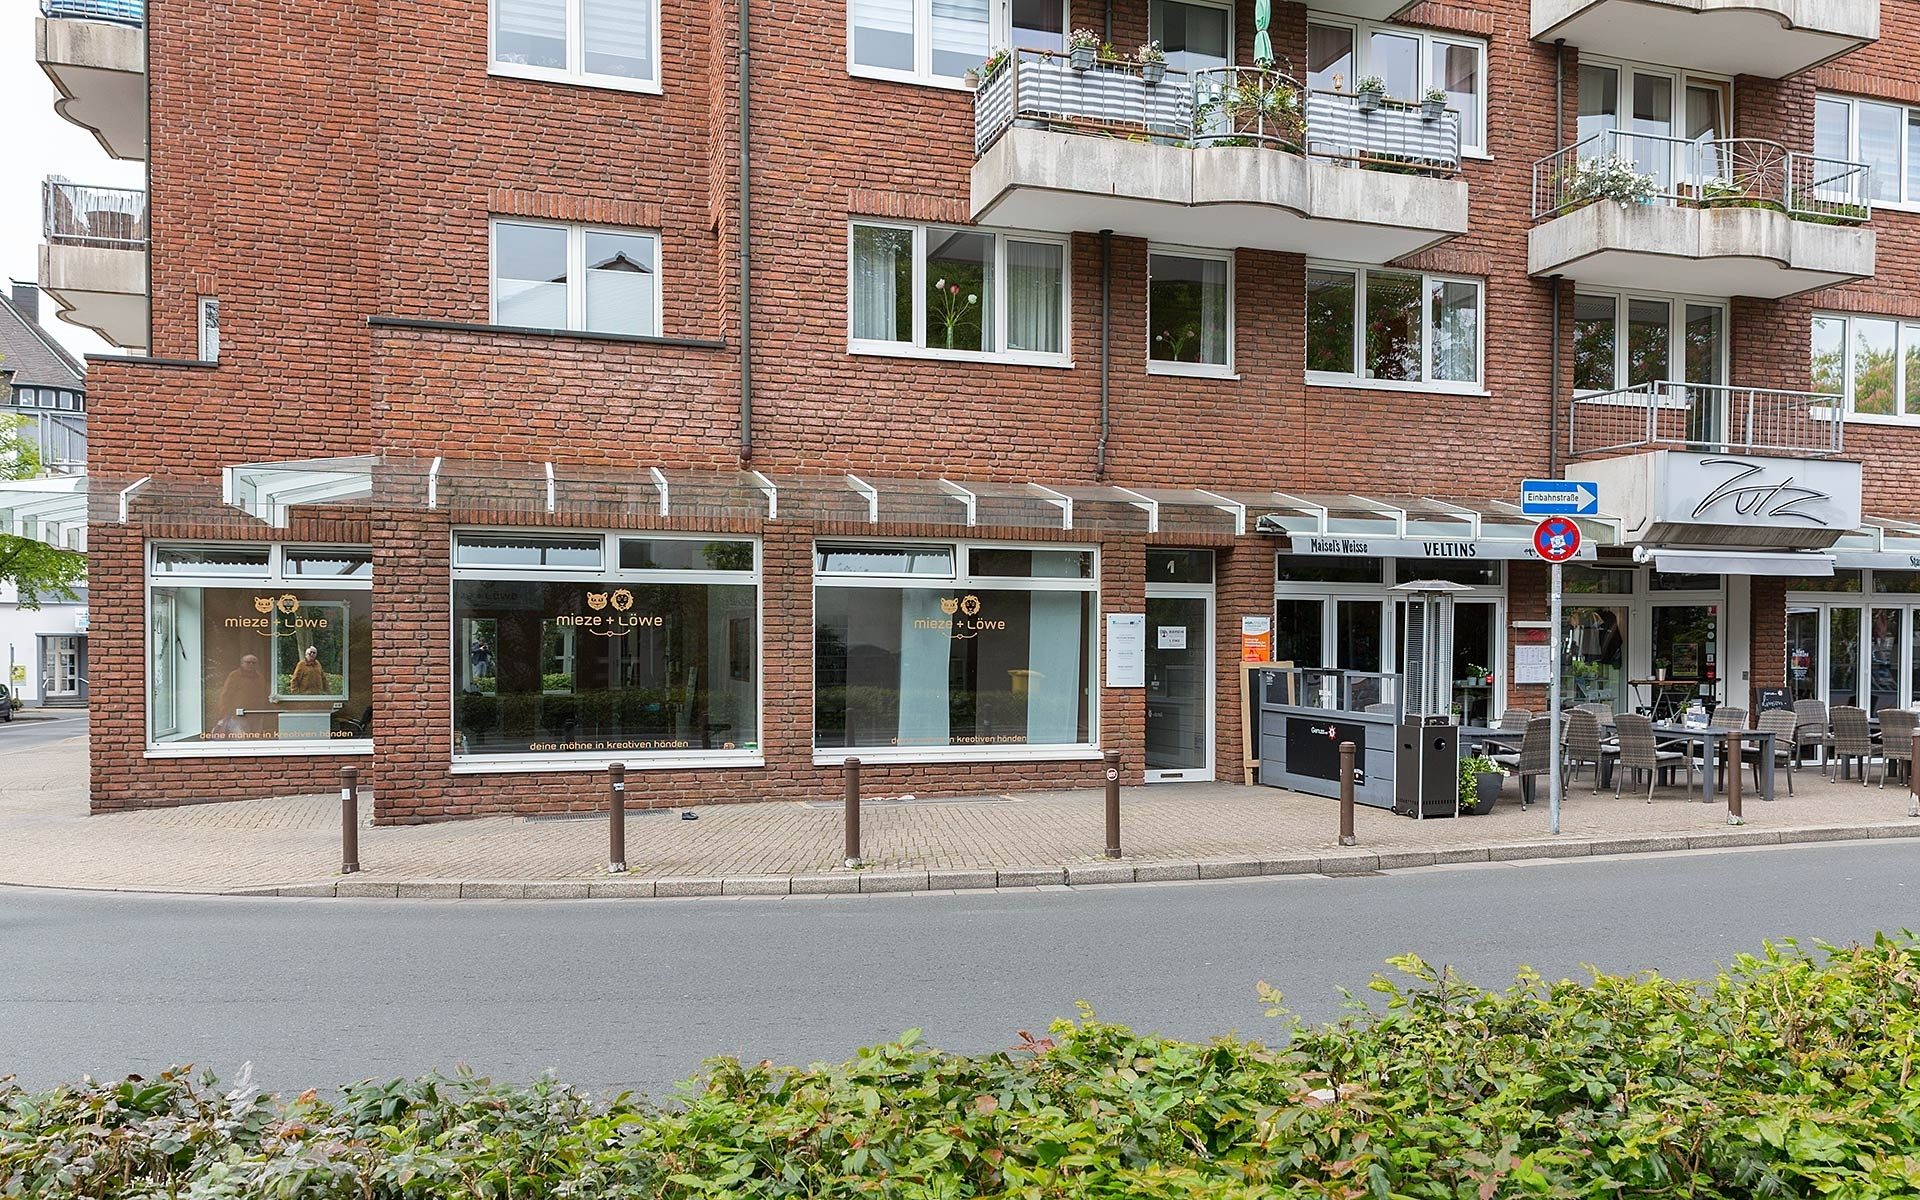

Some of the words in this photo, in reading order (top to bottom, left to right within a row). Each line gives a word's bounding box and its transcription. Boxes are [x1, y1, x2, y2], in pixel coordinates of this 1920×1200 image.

[1527, 493, 1579, 502] Einbahnstraße
[1310, 538, 1341, 553] Maisel's
[1342, 539, 1368, 554] Weisse
[1423, 542, 1476, 557] VELTINS
[1167, 560, 1175, 574] 1
[224, 615, 269, 628] mieze
[284, 615, 328, 628] Löwe
[556, 612, 602, 626] mieze
[605, 616, 615, 625] +
[618, 613, 663, 626] Löwe
[914, 616, 953, 630] mieze
[956, 620, 964, 629] +
[967, 617, 1006, 630] Löwe
[199, 730, 226, 740] deine
[262, 729, 272, 739] in
[956, 734, 995, 744] kreativen
[529, 741, 557, 751] deine
[595, 740, 605, 750] in
[606, 740, 652, 749] kreativen
